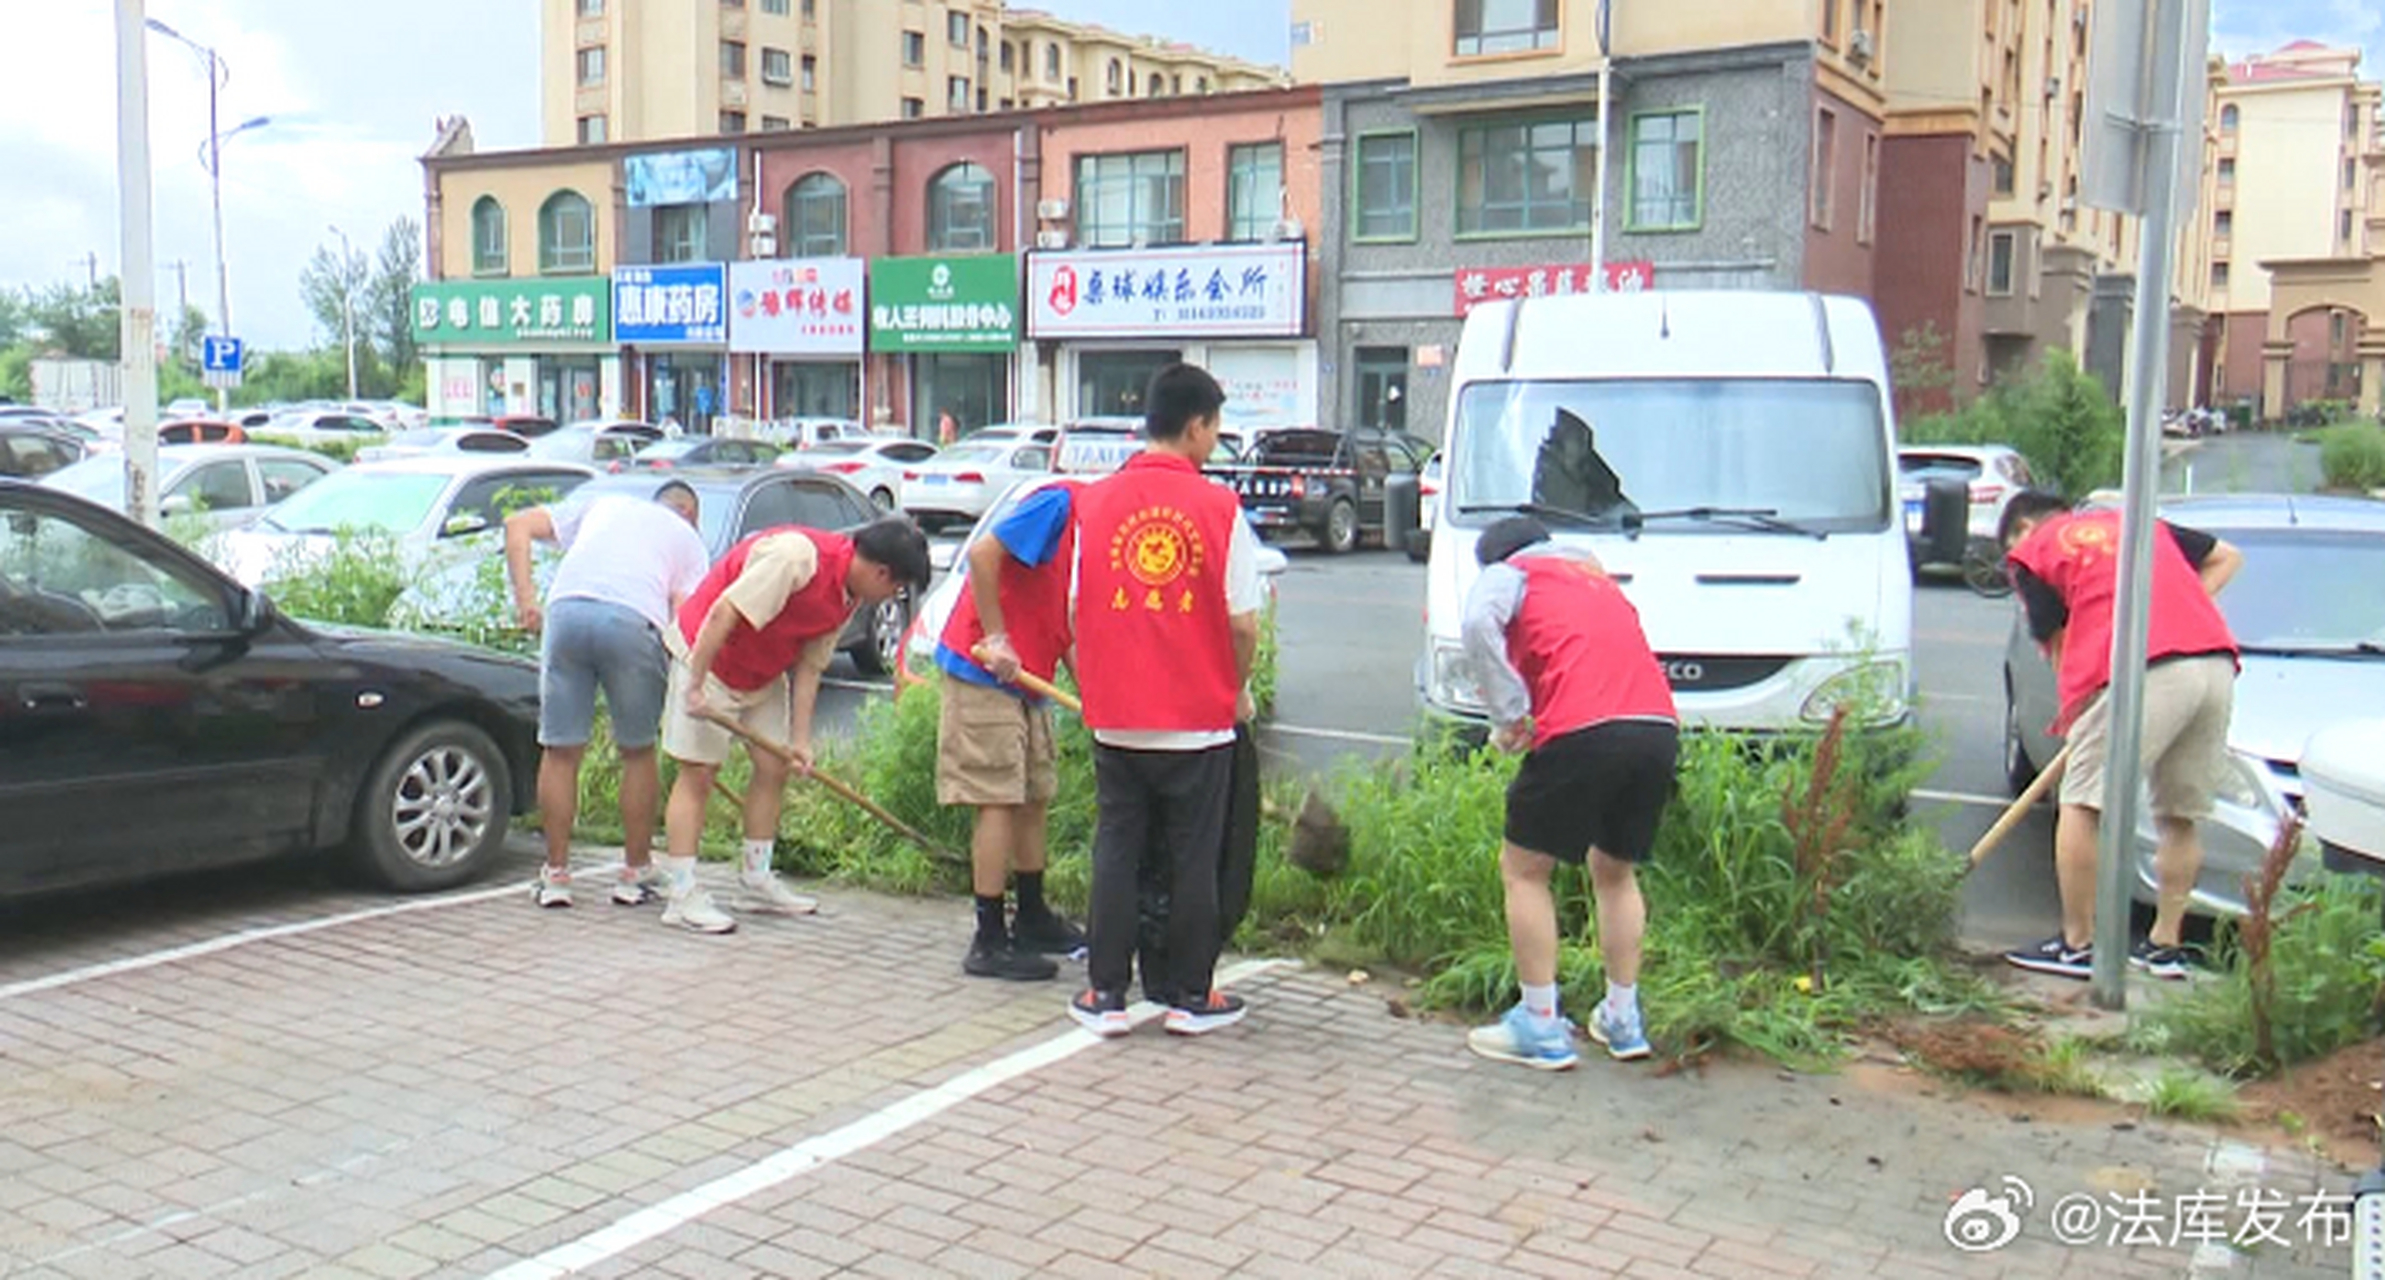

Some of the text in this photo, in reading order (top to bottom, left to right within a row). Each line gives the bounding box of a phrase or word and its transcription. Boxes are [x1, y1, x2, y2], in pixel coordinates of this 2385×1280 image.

[618, 285, 719, 326] 惠康药房
[1082, 264, 1269, 306] 桌球娱乐会所
[210, 341, 236, 367] P
